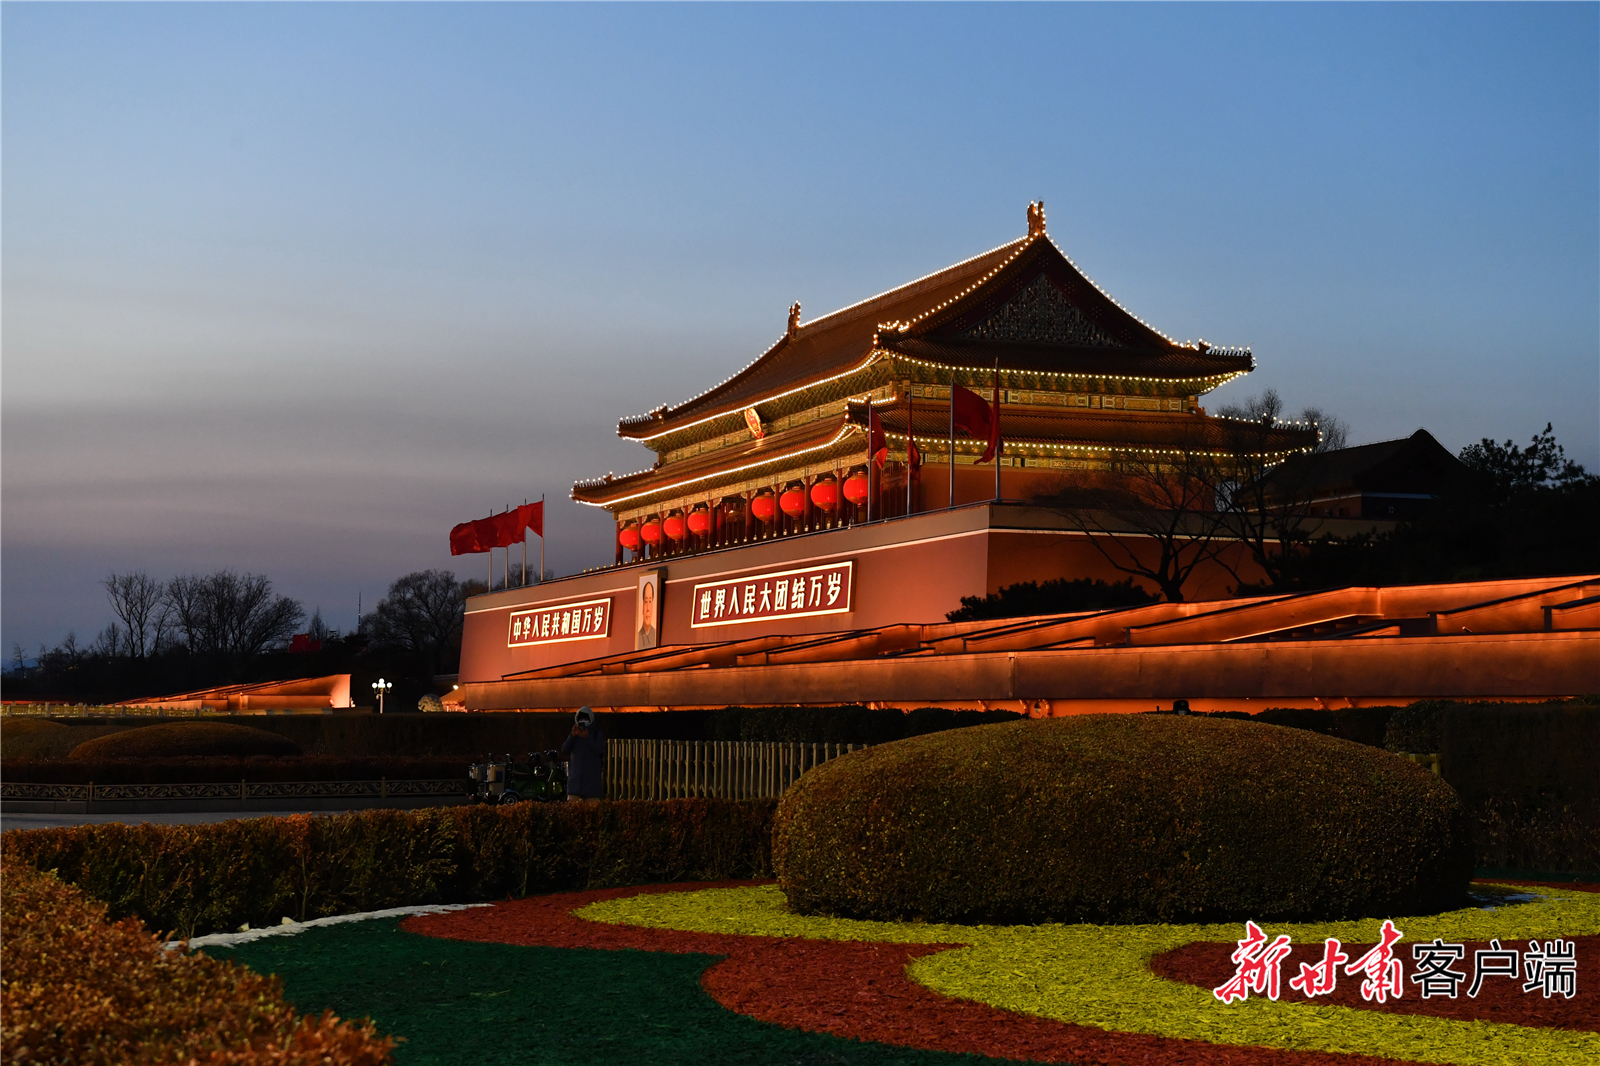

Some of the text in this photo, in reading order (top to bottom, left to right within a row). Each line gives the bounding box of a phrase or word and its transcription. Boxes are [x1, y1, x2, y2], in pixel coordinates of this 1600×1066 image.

[700, 572, 843, 620] 世界人民大团结万岁
[512, 606, 605, 641] 中华人民共和国万岁
